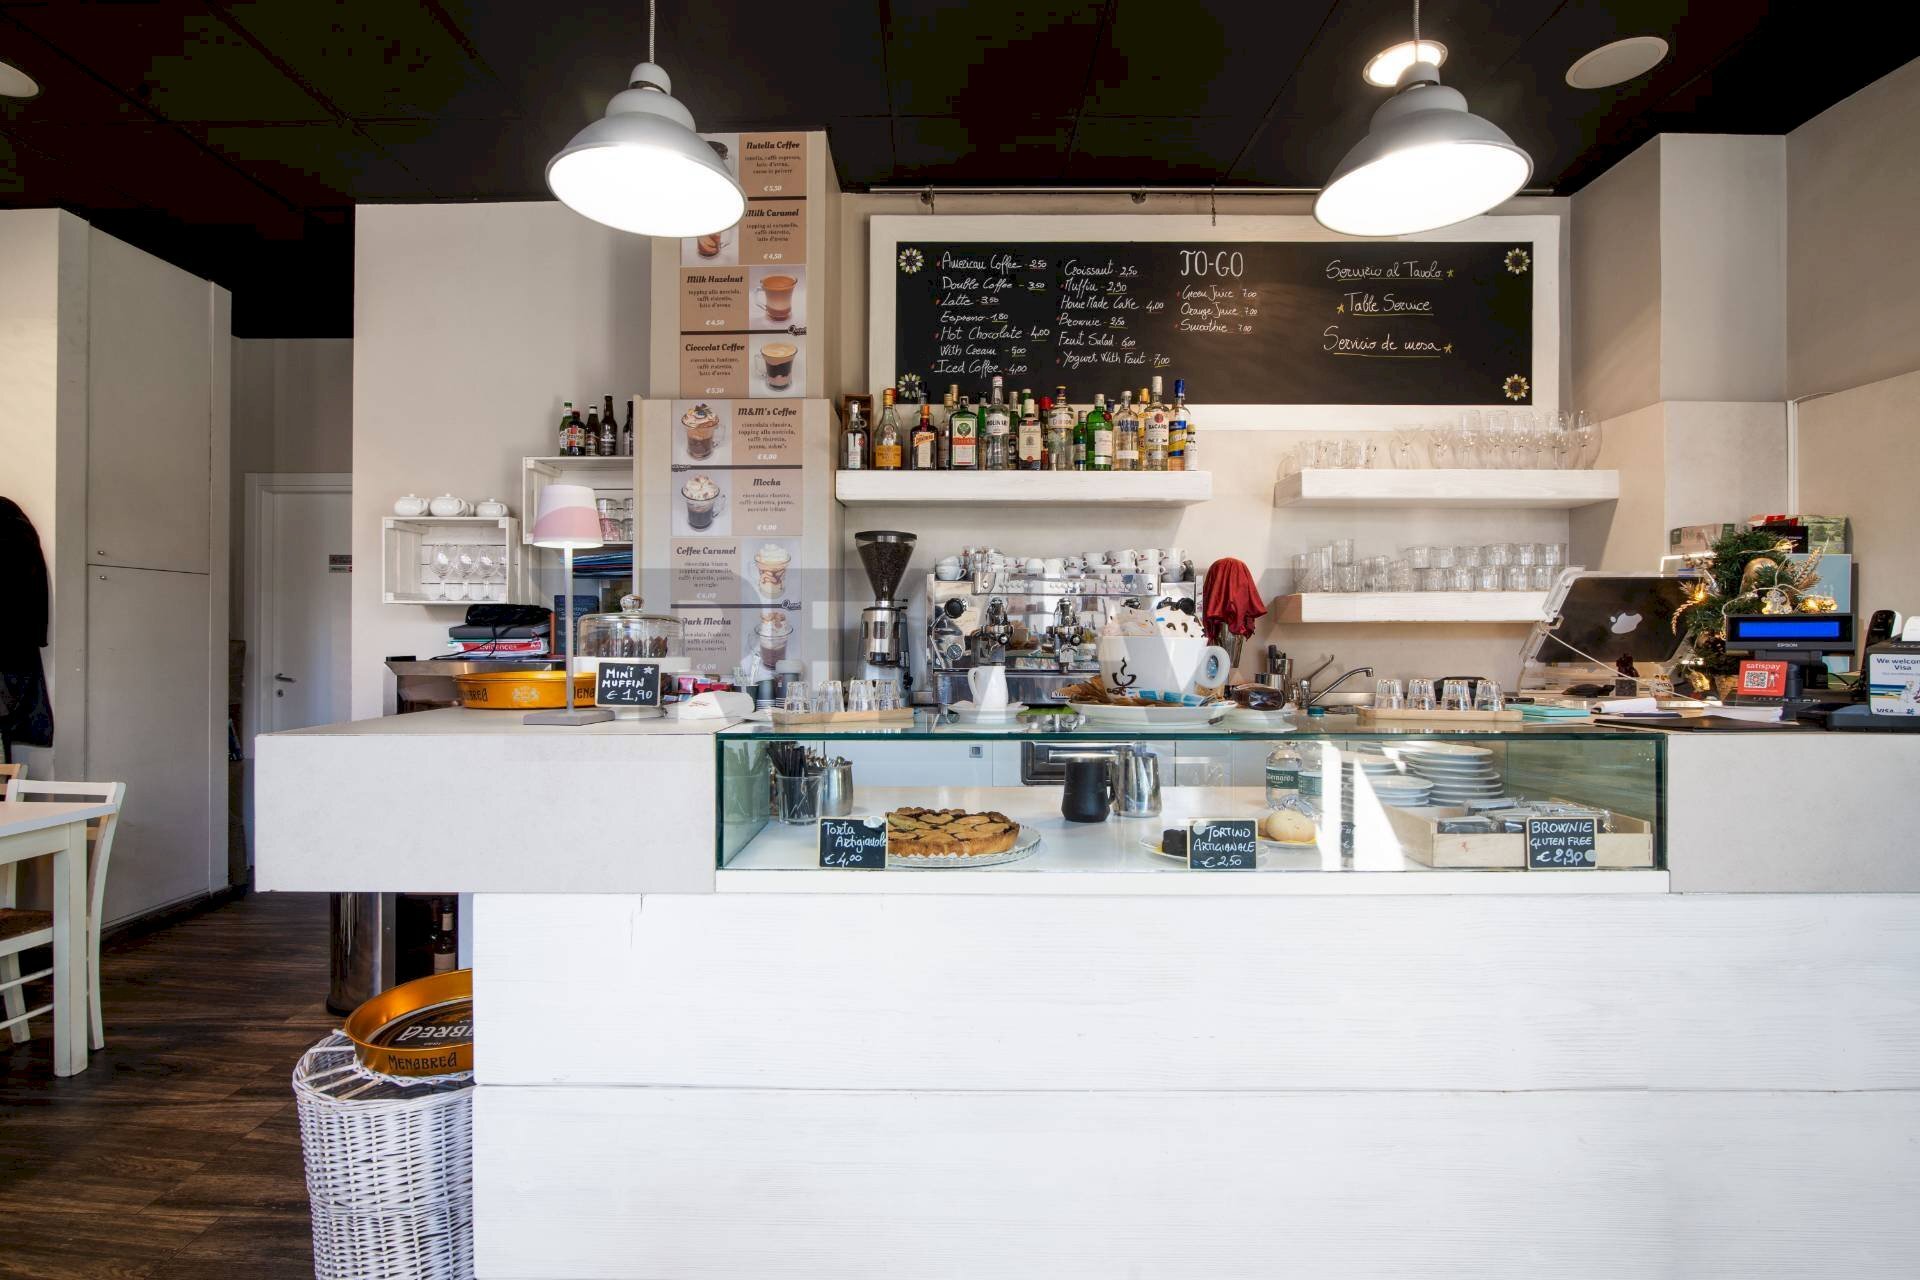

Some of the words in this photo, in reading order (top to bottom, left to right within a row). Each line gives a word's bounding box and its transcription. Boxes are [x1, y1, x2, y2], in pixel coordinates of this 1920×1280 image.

[746, 141, 775, 149] Nutella
[776, 140, 800, 150] Coffee
[745, 209, 765, 217] Milk
[766, 208, 800, 217] Caramel
[942, 251, 986, 270] American
[990, 254, 1022, 275] Coffee
[1064, 259, 1114, 276] Croissant
[1180, 250, 1244, 277] TO-GO
[1386, 261, 1400, 277] al
[1403, 260, 1442, 278] Tavolo
[687, 275, 707, 284] Milk
[708, 274, 743, 283] Hazelnut
[942, 276, 980, 290] Double
[983, 277, 1013, 294] Coffee
[1064, 276, 1098, 299] Muffin
[941, 292, 974, 306] Latte
[1344, 291, 1380, 312] Table
[1383, 293, 1433, 312] Service
[1180, 302, 1213, 320] Orange
[1059, 312, 1101, 327] Brownie
[940, 326, 964, 341] Hot
[969, 324, 1023, 340] Chocolate
[1089, 332, 1114, 346] Salad
[1323, 325, 1377, 351] Servicio
[1381, 333, 1398, 350] de
[1404, 341, 1441, 351] mesa
[721, 342, 745, 352] Coffee
[940, 344, 962, 356] With
[966, 344, 997, 355] Cream
[1063, 351, 1098, 370] Yogurt
[1100, 351, 1121, 364] With
[933, 359, 965, 373] Iced
[969, 359, 1003, 379] Coffee
[738, 407, 771, 416] M&M's
[772, 407, 797, 417] Coffee
[753, 478, 781, 486] Mocha
[676, 546, 701, 556] Coffee
[702, 546, 737, 555] Caramel
[703, 617, 731, 626] Mocha
[1746, 662, 1781, 670] satispay
[602, 677, 645, 688] MUFFIN
[606, 690, 618, 700] €
[621, 688, 653, 702] 1,90
[821, 821, 856, 836] Torta
[1206, 825, 1251, 842] TORTINO
[1531, 821, 1593, 834] BROWNIE
[1193, 838, 1256, 853] ARTIGIANALE
[1530, 837, 1565, 850] GLUTEN
[1567, 836, 1593, 846] FREE
[824, 853, 835, 865] €
[836, 852, 862, 869] 4,00
[1200, 857, 1216, 868] €
[1536, 851, 1551, 862] €
[1553, 848, 1584, 866] 2,90
